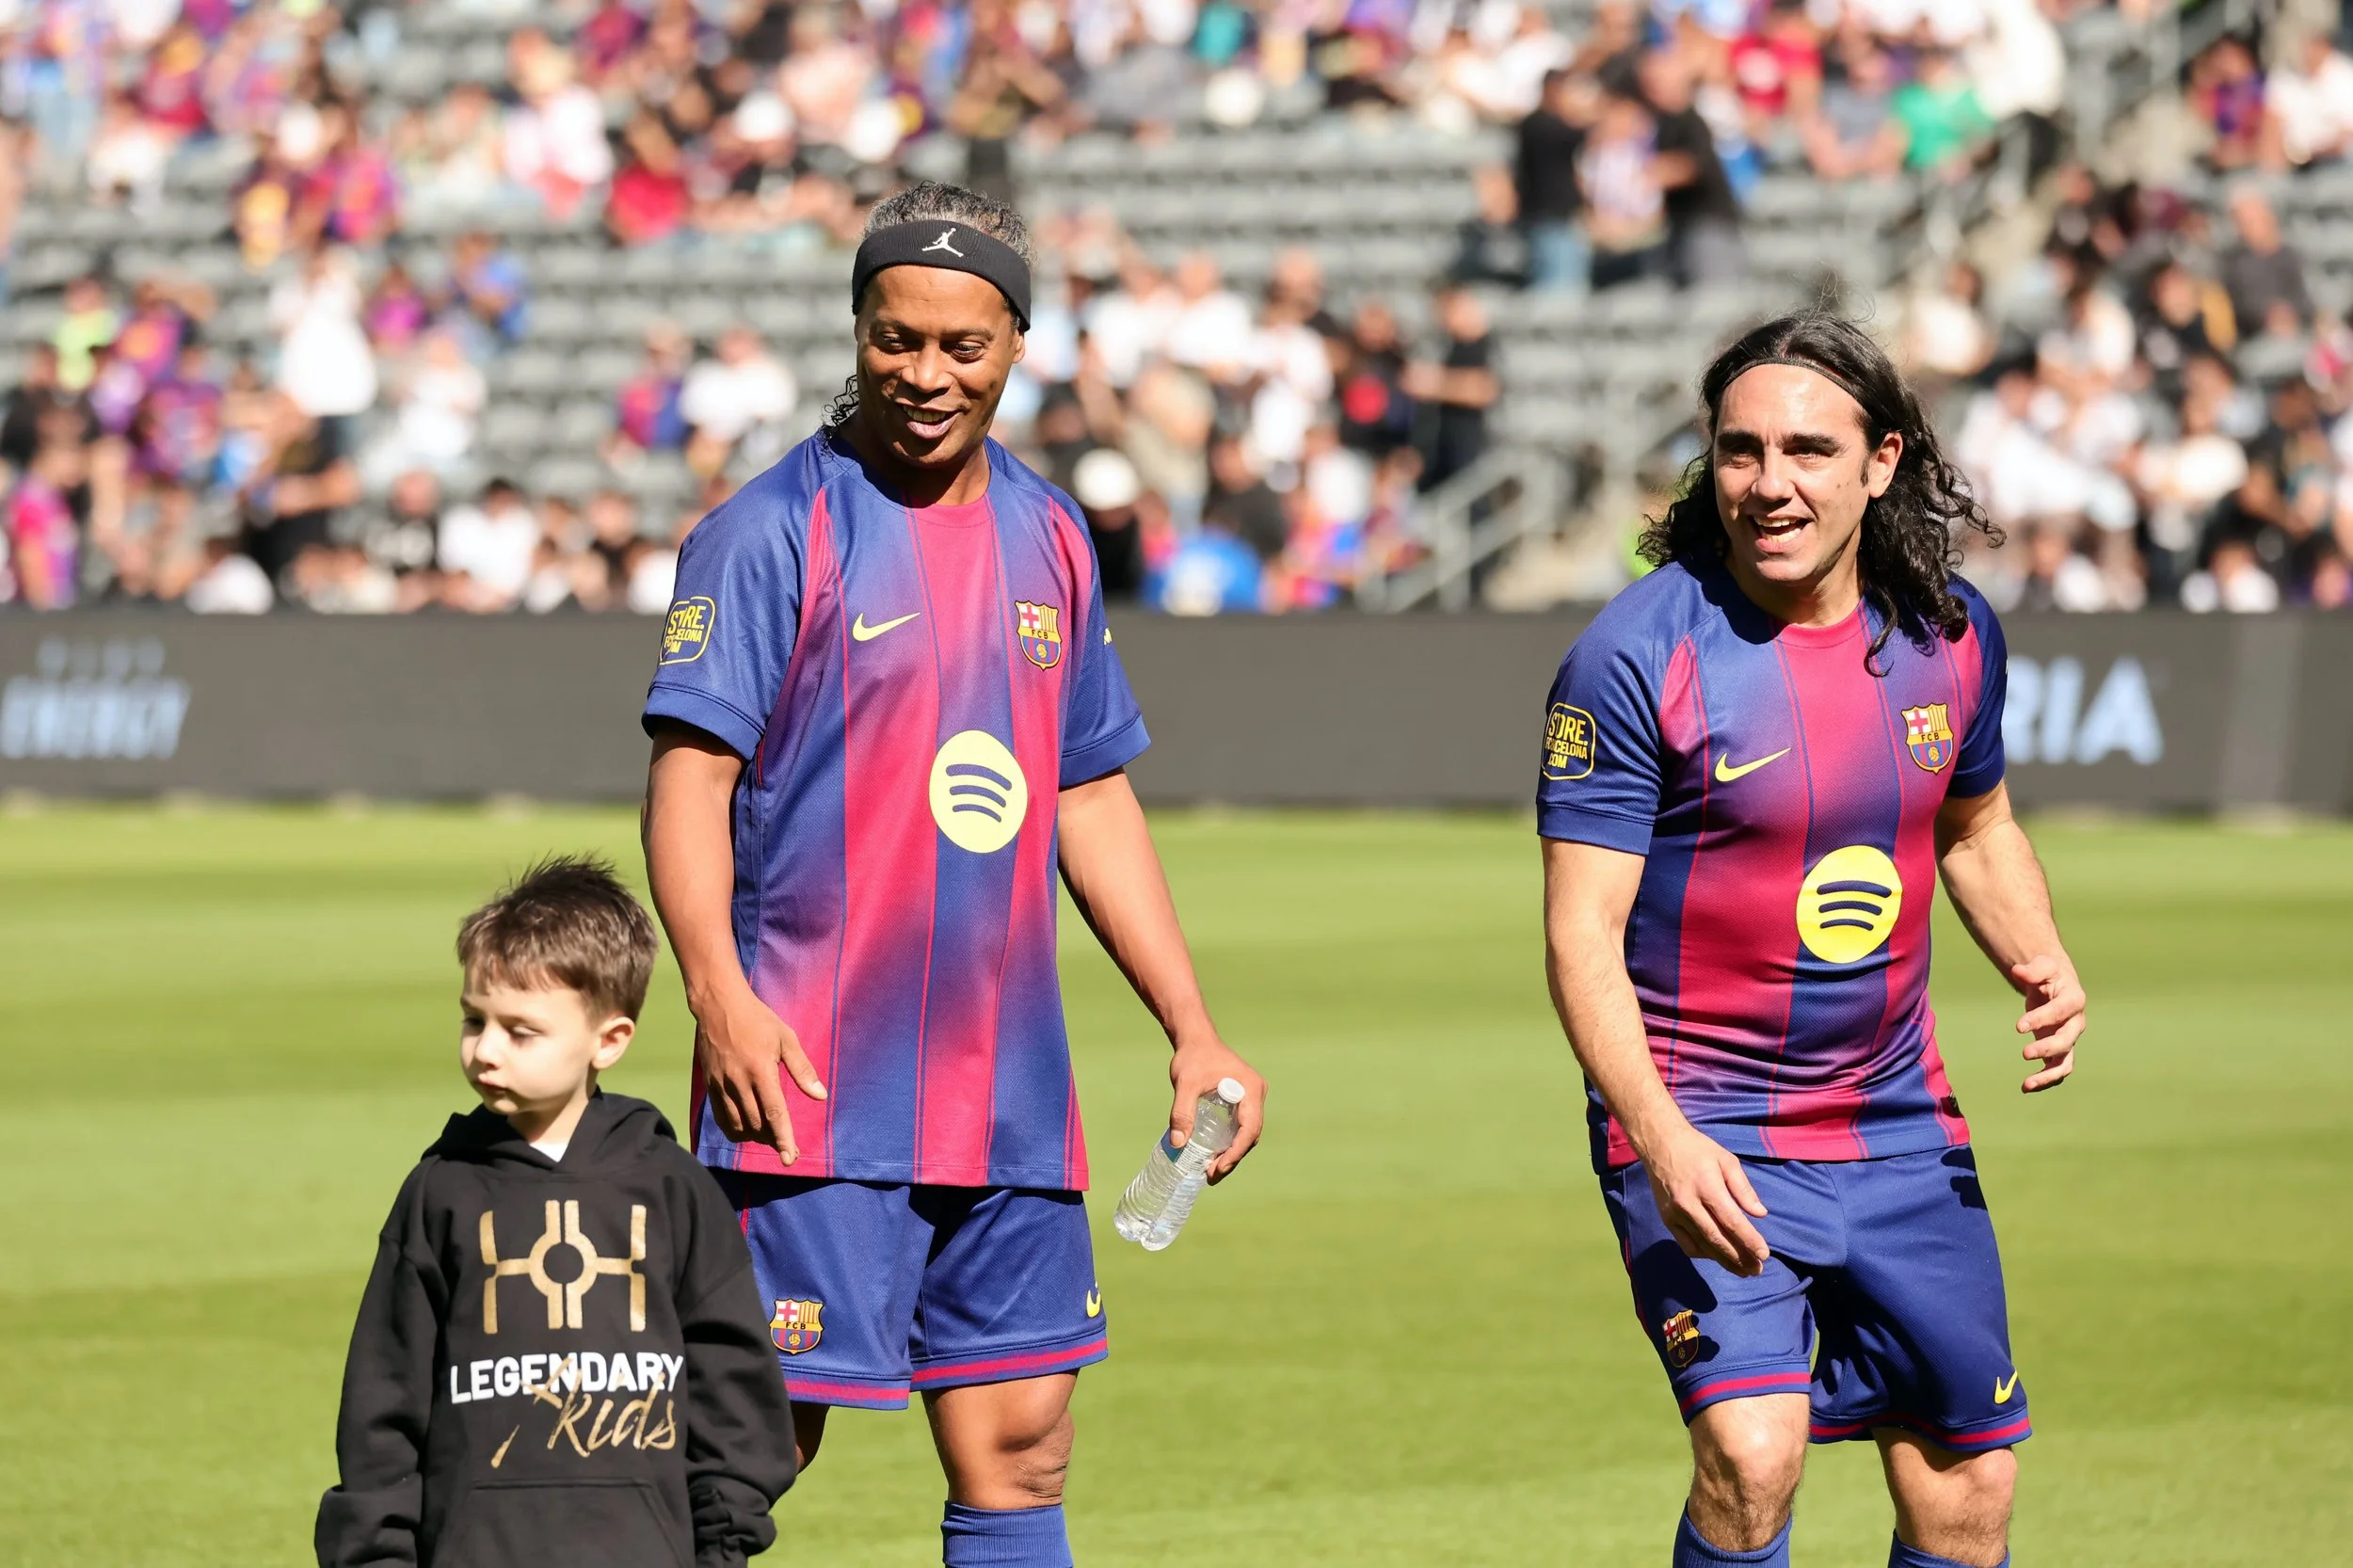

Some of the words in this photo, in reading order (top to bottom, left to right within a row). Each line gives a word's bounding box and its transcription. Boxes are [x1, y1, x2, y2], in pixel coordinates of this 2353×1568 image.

[1032, 629, 1048, 640] FCB
[1921, 732, 1940, 743] FCB
[785, 1321, 807, 1331] FCB
[450, 1352, 683, 1404] LEGENDARY
